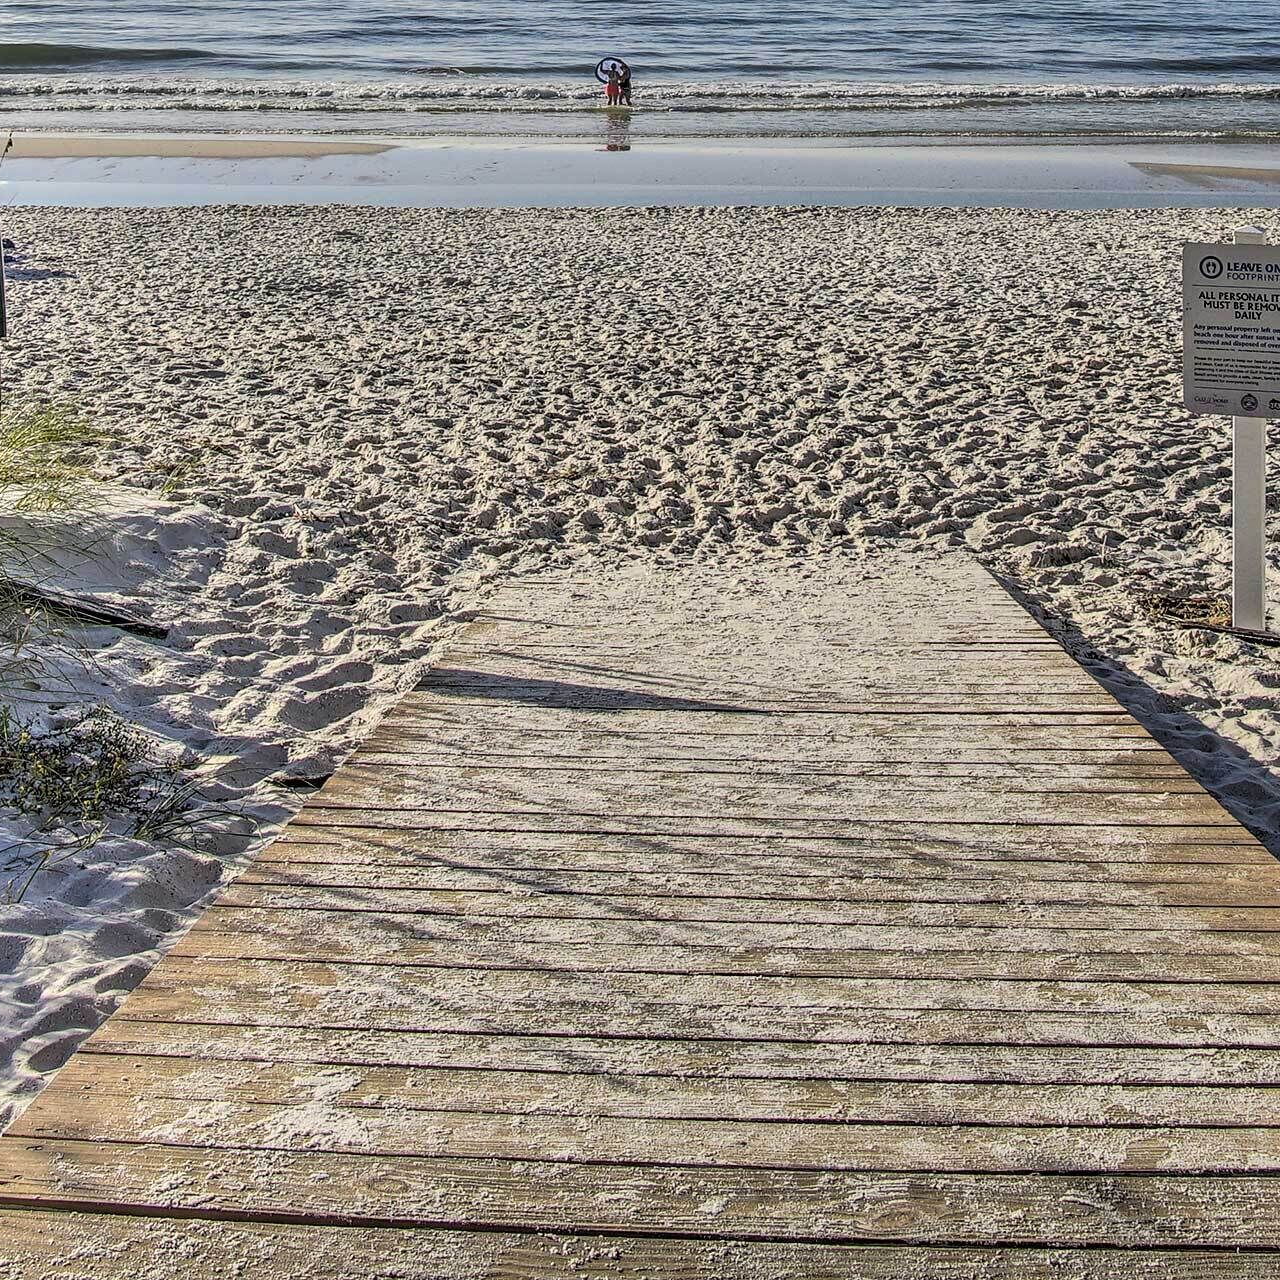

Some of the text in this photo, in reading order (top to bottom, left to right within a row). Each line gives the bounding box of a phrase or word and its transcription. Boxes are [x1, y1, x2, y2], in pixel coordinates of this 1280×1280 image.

[1226, 262, 1262, 272] LEAVE
[1199, 291, 1216, 300] ALL
[1218, 292, 1268, 302] PERSONAL
[1203, 300, 1230, 309] MUST
[1233, 302, 1244, 310] BE
[1235, 311, 1262, 320] DAILY
